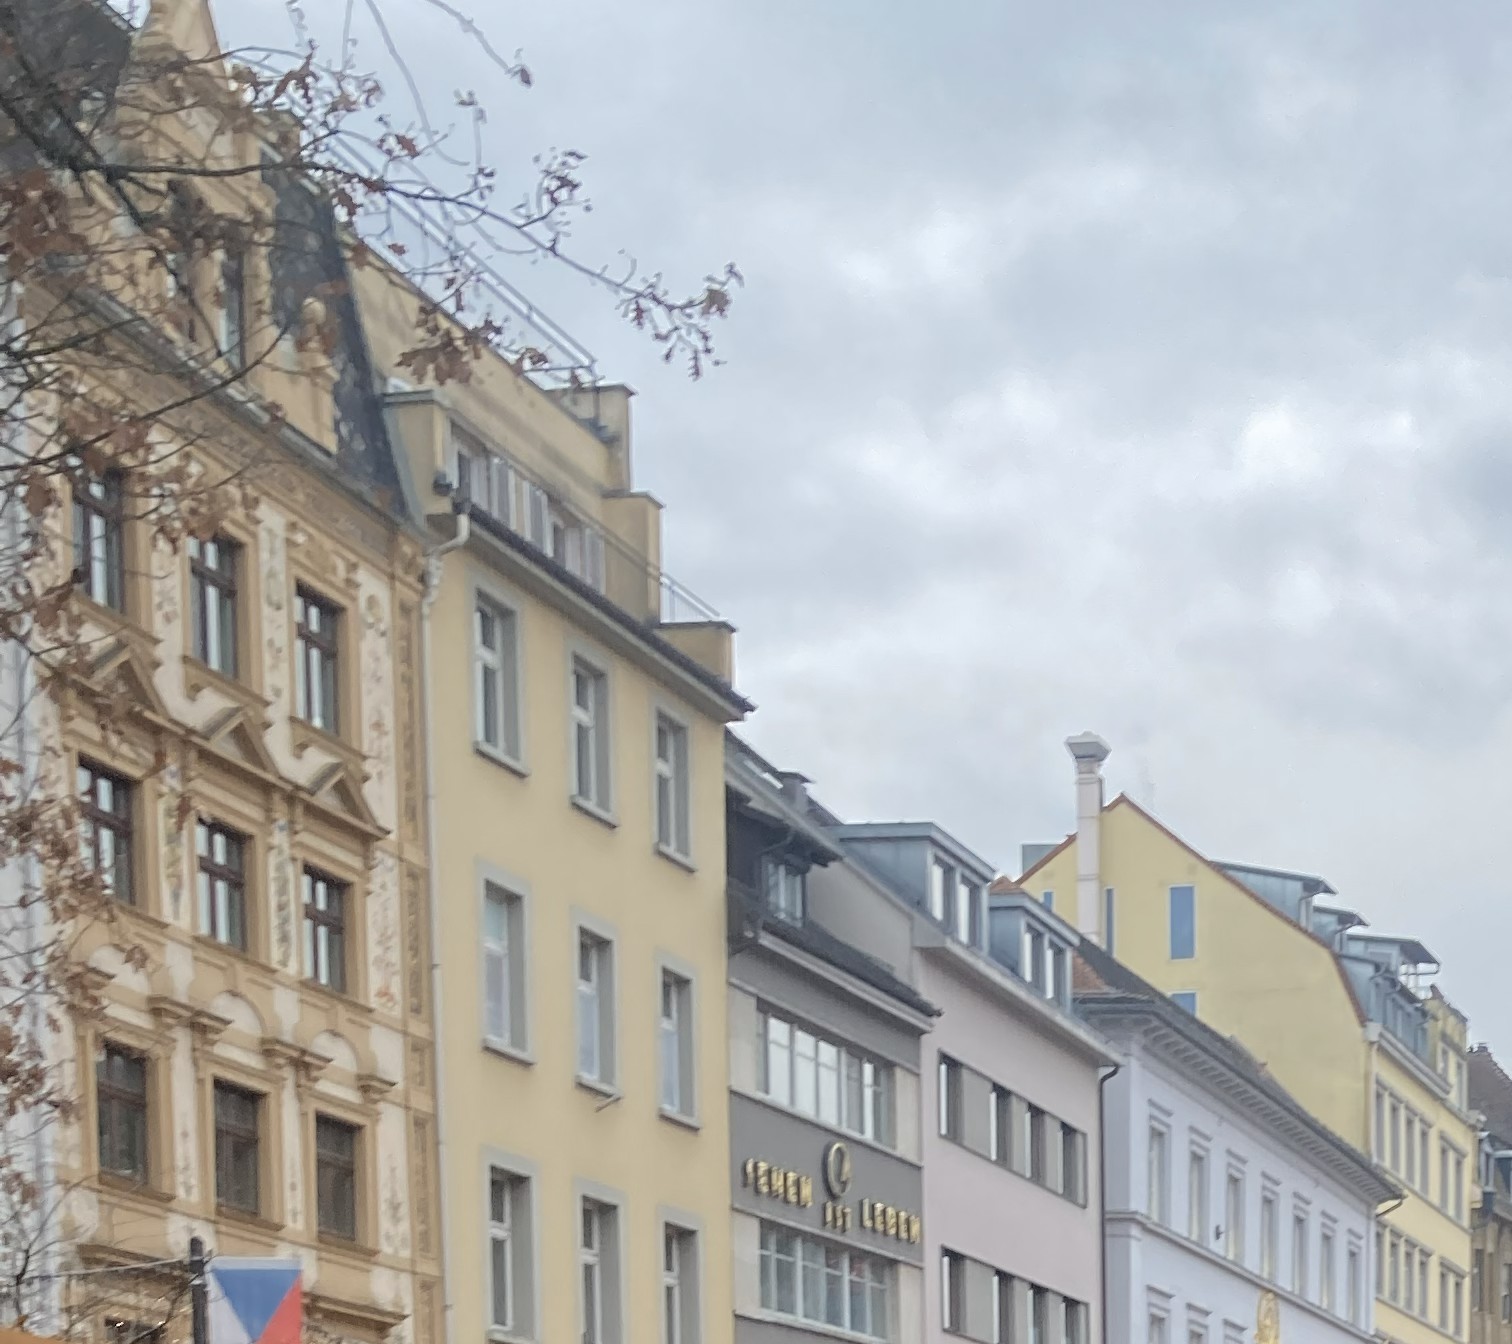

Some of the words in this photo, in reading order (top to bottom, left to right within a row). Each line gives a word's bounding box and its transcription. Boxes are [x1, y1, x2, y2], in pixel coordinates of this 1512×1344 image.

[744, 1158, 813, 1209] SEHEN
[824, 1200, 852, 1233] IST
[862, 1197, 921, 1244] LEBEN
